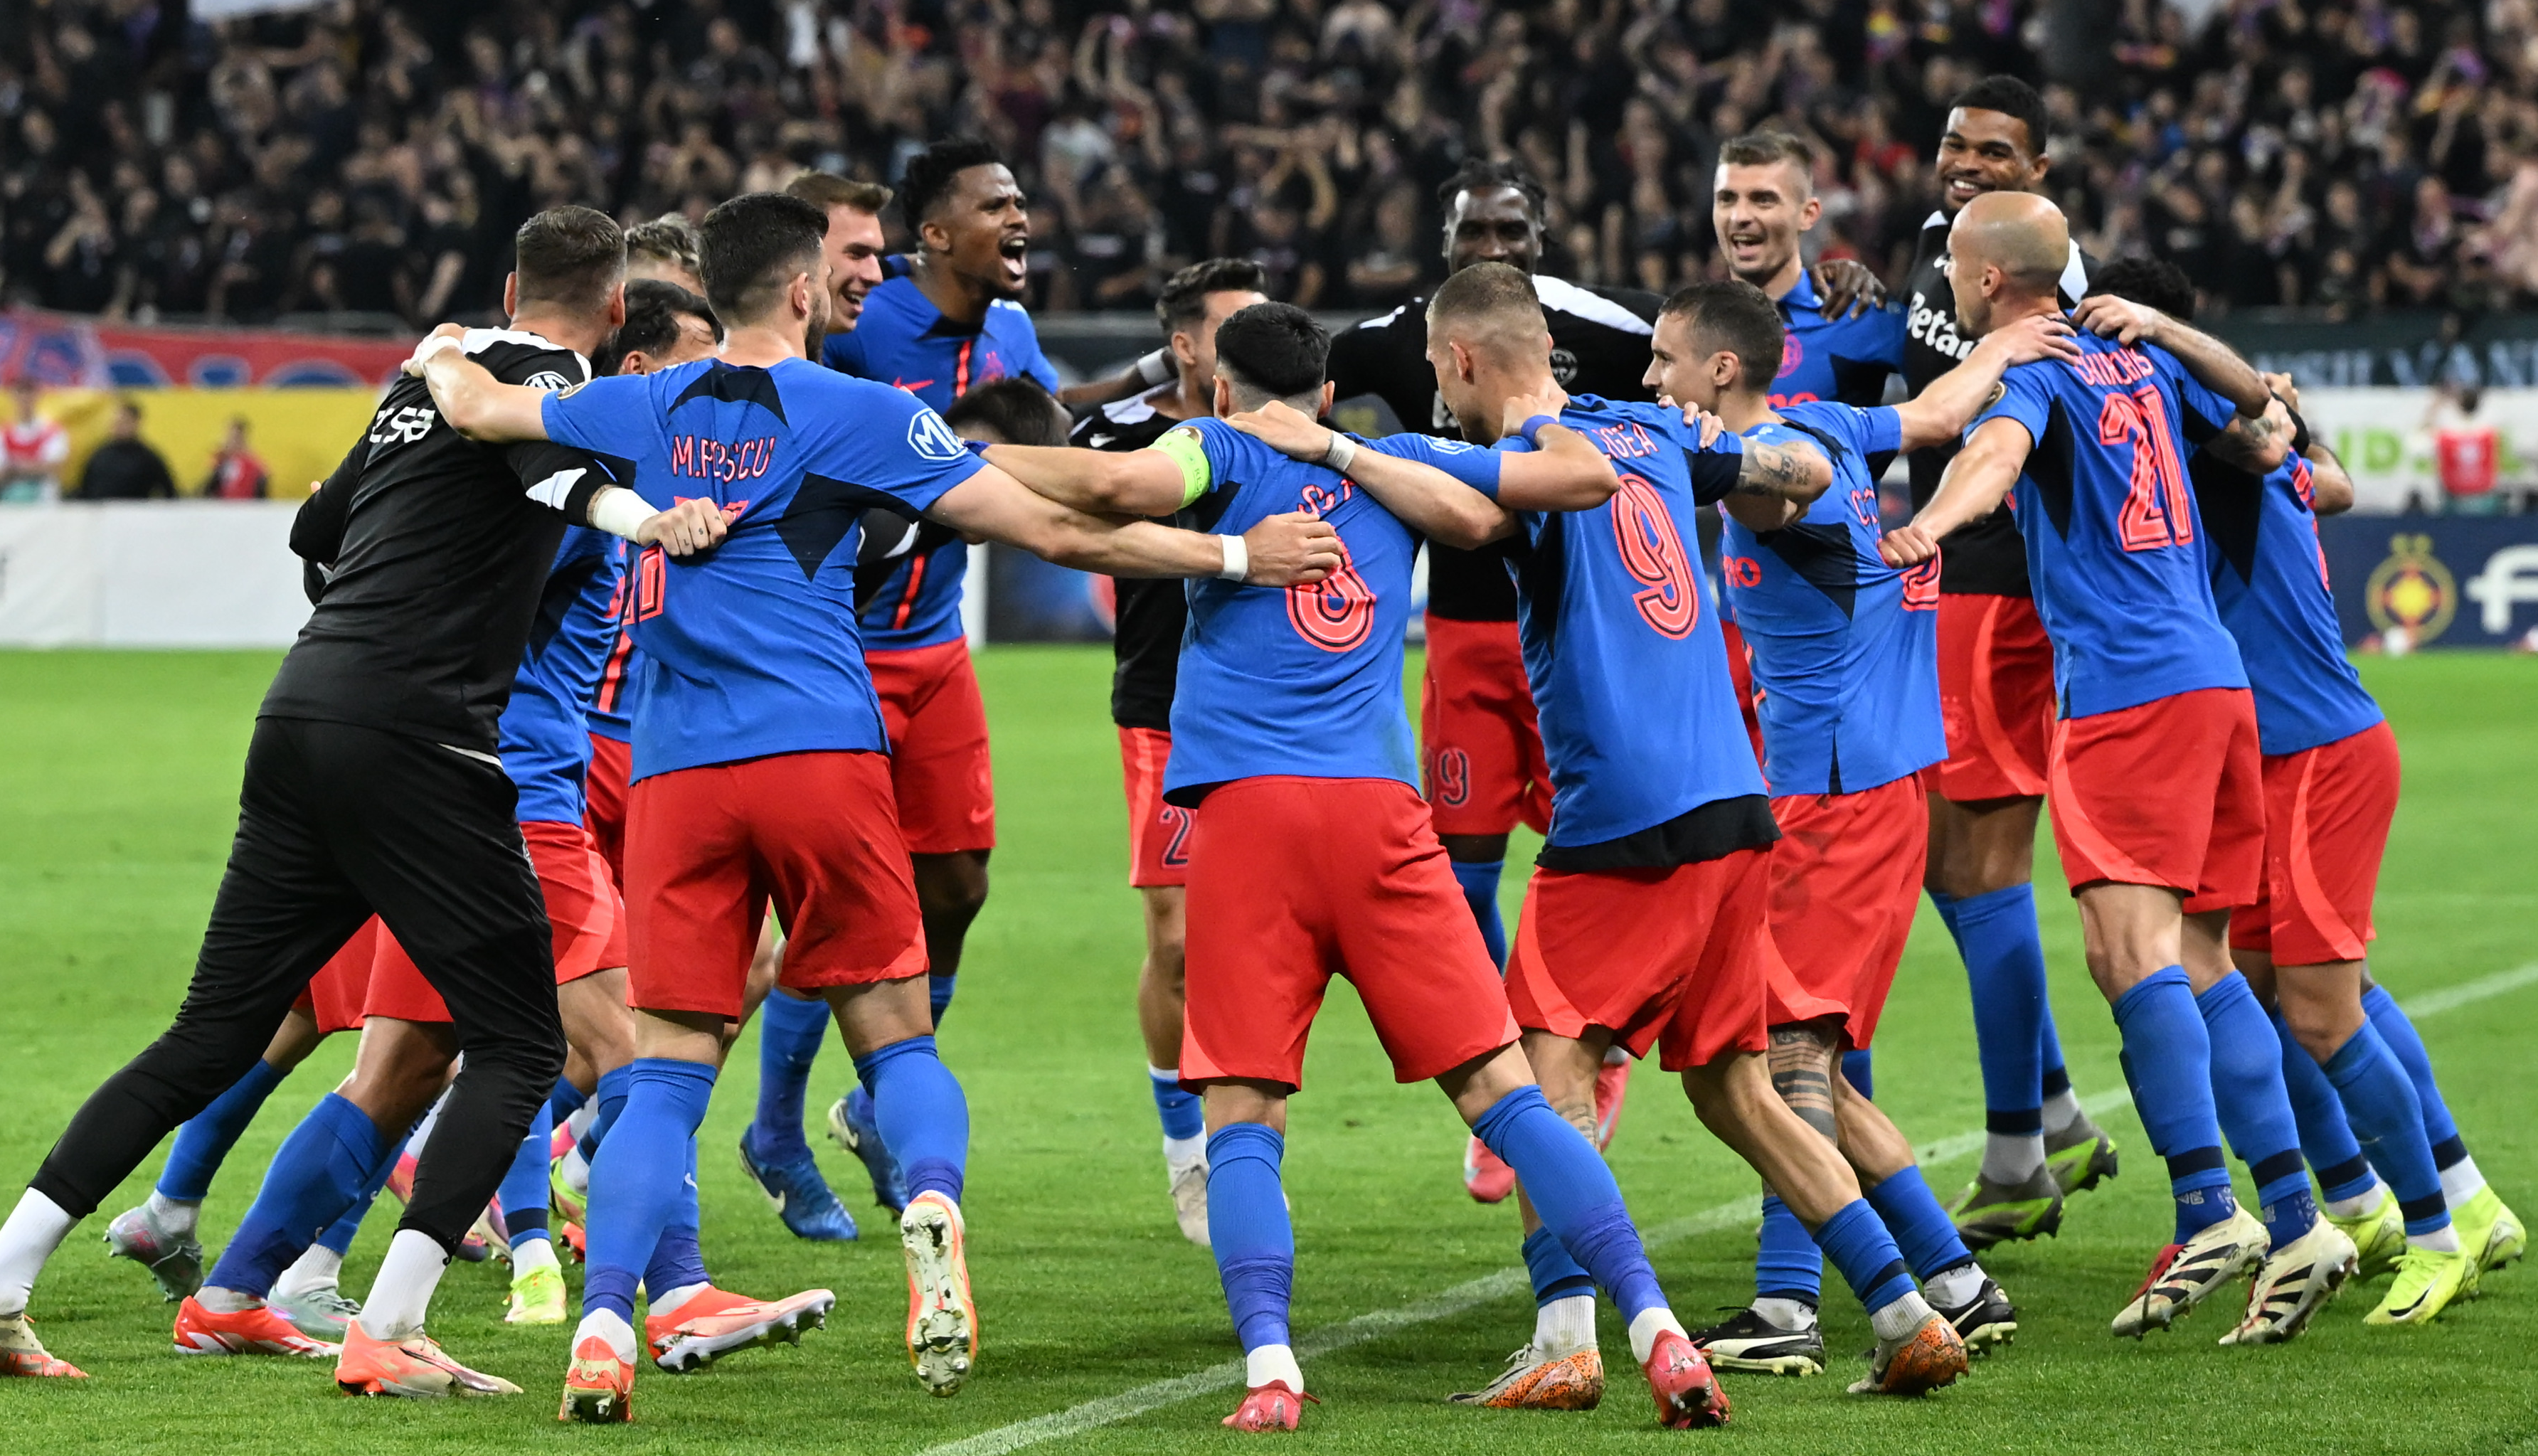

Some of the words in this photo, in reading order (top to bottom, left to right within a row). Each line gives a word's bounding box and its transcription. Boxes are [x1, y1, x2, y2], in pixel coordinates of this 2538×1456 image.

[2098, 384, 2194, 552] 21
[1611, 473, 1699, 640] 9
[1158, 804, 1198, 868] 2
